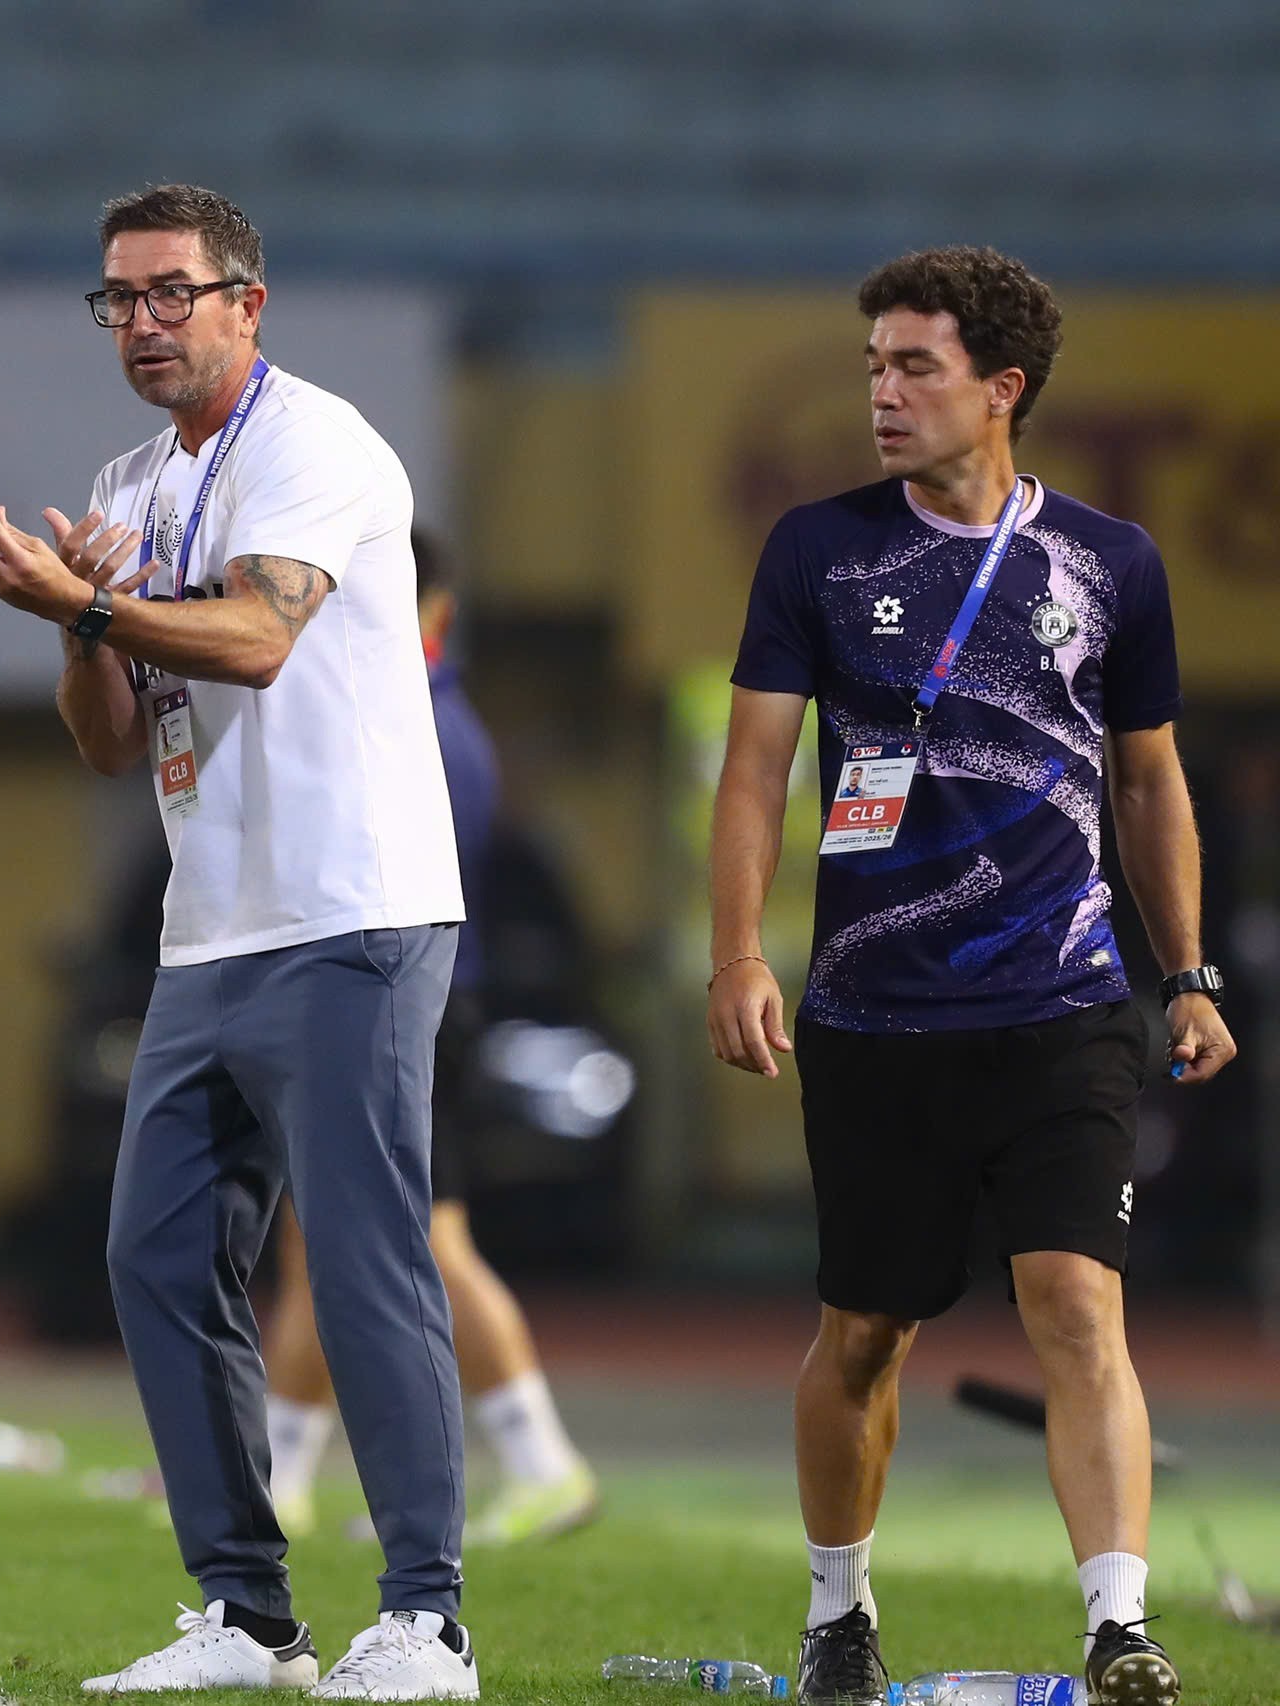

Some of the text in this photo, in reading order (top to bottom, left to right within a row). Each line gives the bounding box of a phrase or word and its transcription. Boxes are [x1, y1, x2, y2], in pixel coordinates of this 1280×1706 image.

[210, 416, 242, 474] PROFESSIONAL
[237, 377, 261, 415] FOOTBALL
[975, 500, 1020, 589] VIETNAM PROFESSIONAL
[1038, 604, 1070, 616] HANOI
[938, 638, 957, 664] VPF
[169, 761, 188, 782] CLB
[847, 804, 886, 822] CLB
